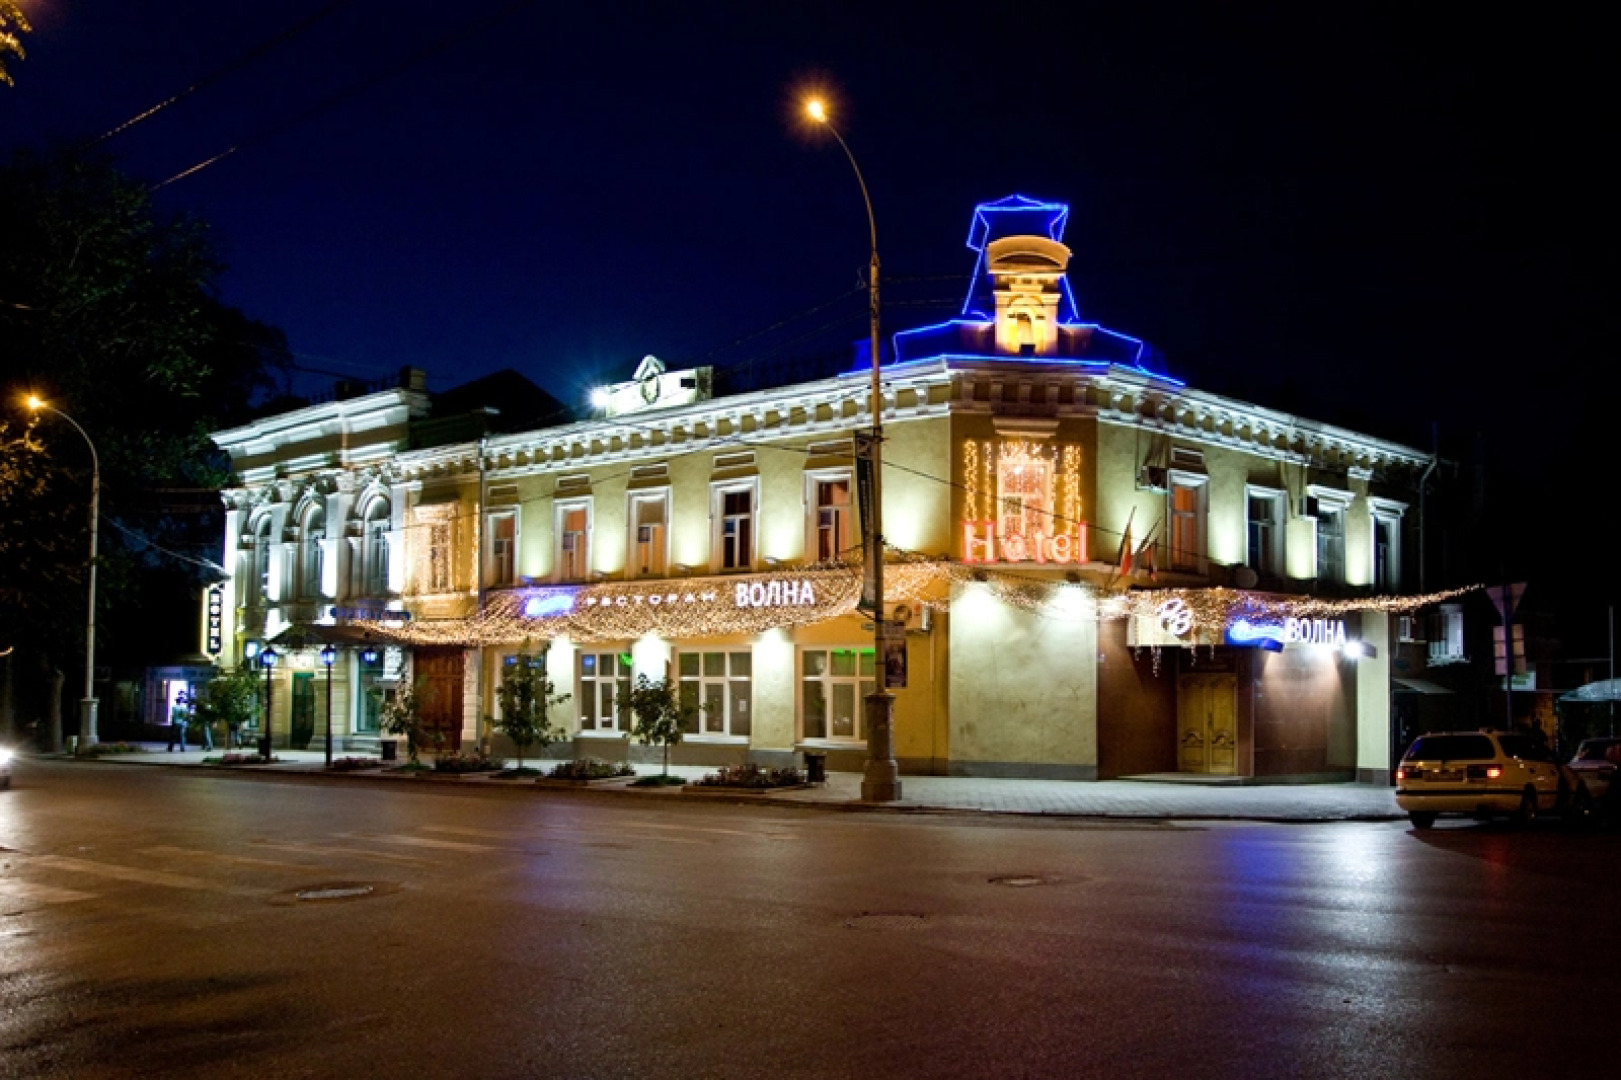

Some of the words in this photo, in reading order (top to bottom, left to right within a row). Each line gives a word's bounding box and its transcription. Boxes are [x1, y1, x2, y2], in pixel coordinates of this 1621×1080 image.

[961, 520, 1089, 564] Hotel
[734, 580, 817, 607] ВОЛНА
[1285, 617, 1346, 645] ВОЛНА
